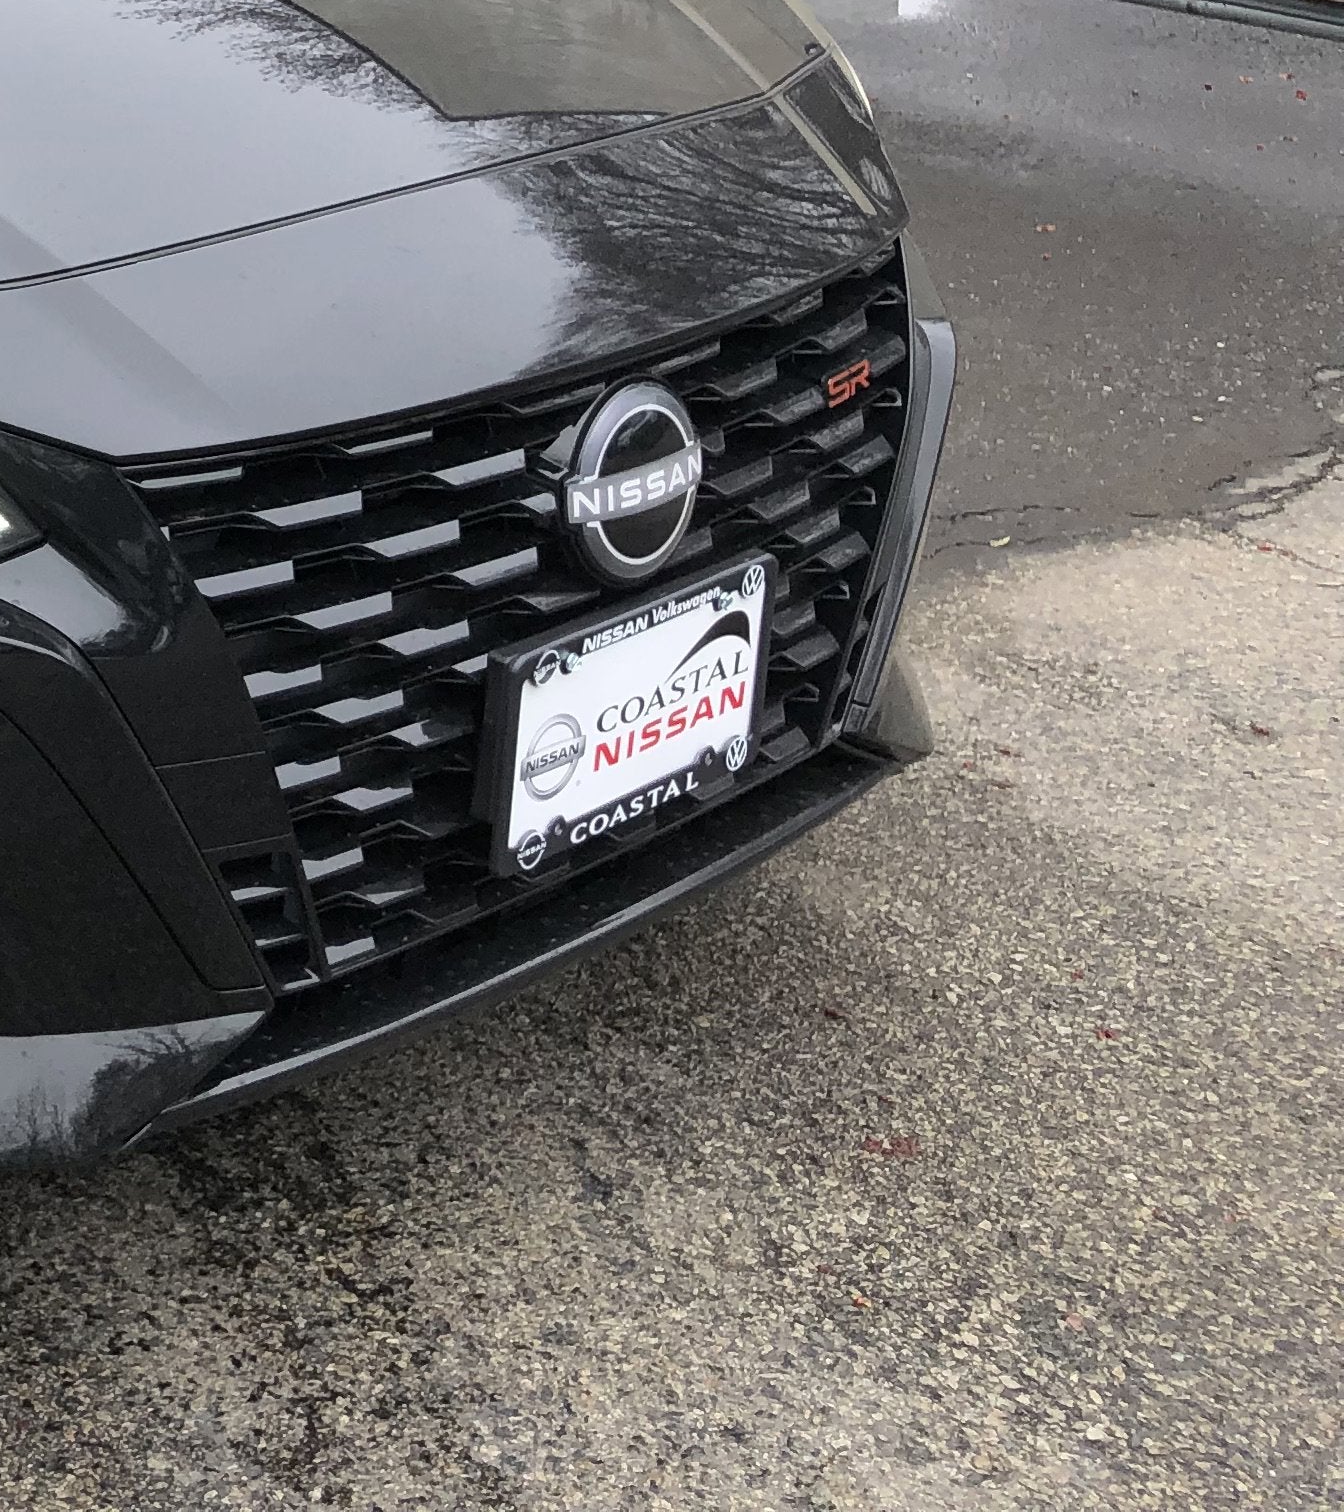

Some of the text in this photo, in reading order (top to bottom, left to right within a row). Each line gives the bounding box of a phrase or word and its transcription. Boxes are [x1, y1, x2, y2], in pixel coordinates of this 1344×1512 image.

[827, 358, 871, 408] SR
[573, 445, 702, 518] NISSAN
[582, 586, 721, 654] NISSAN Volkswagen
[593, 680, 746, 772] NISSAN
[596, 649, 749, 733] COASTAL
[525, 741, 580, 774] NISSAN
[569, 771, 700, 844] COASTAL
